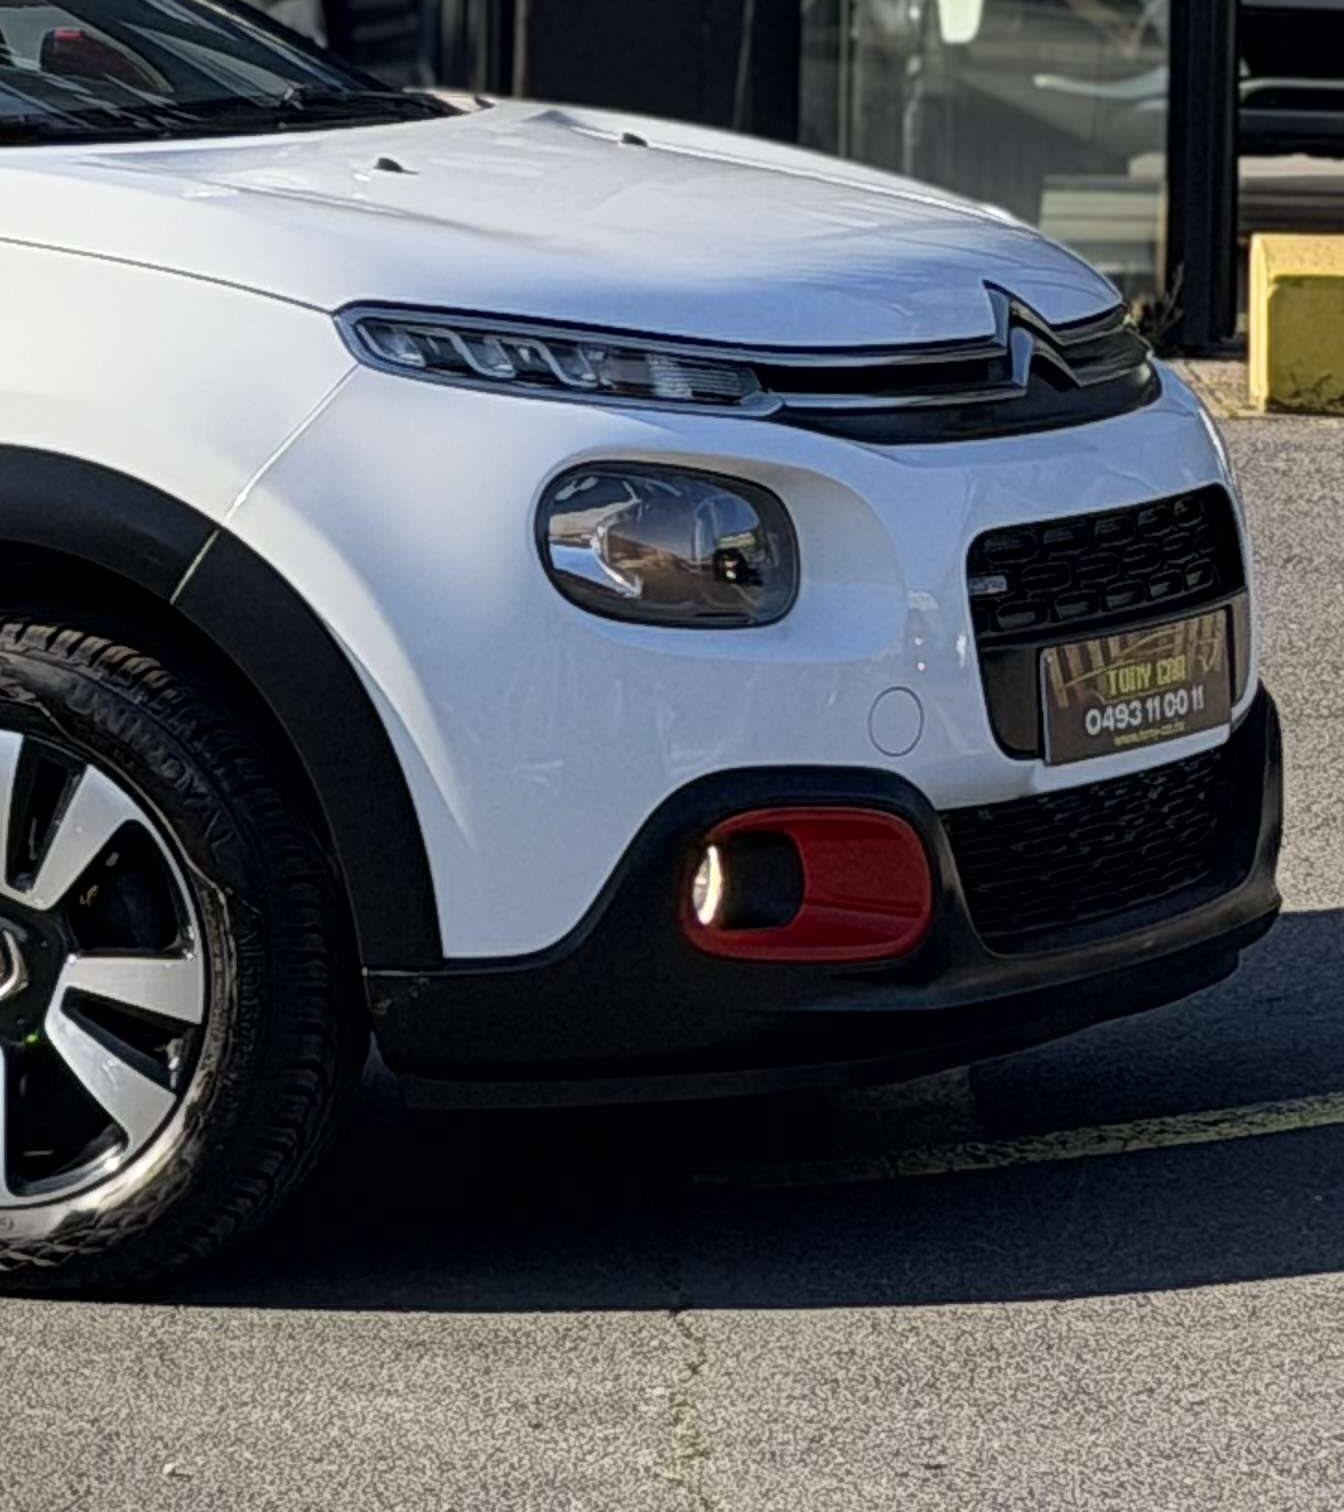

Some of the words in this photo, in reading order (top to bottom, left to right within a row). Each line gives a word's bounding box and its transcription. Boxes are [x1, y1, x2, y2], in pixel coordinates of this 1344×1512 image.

[1085, 701, 1142, 735] 0493
[1146, 697, 1160, 723] 11
[1163, 689, 1188, 717] 00
[1191, 685, 1204, 711] 11
